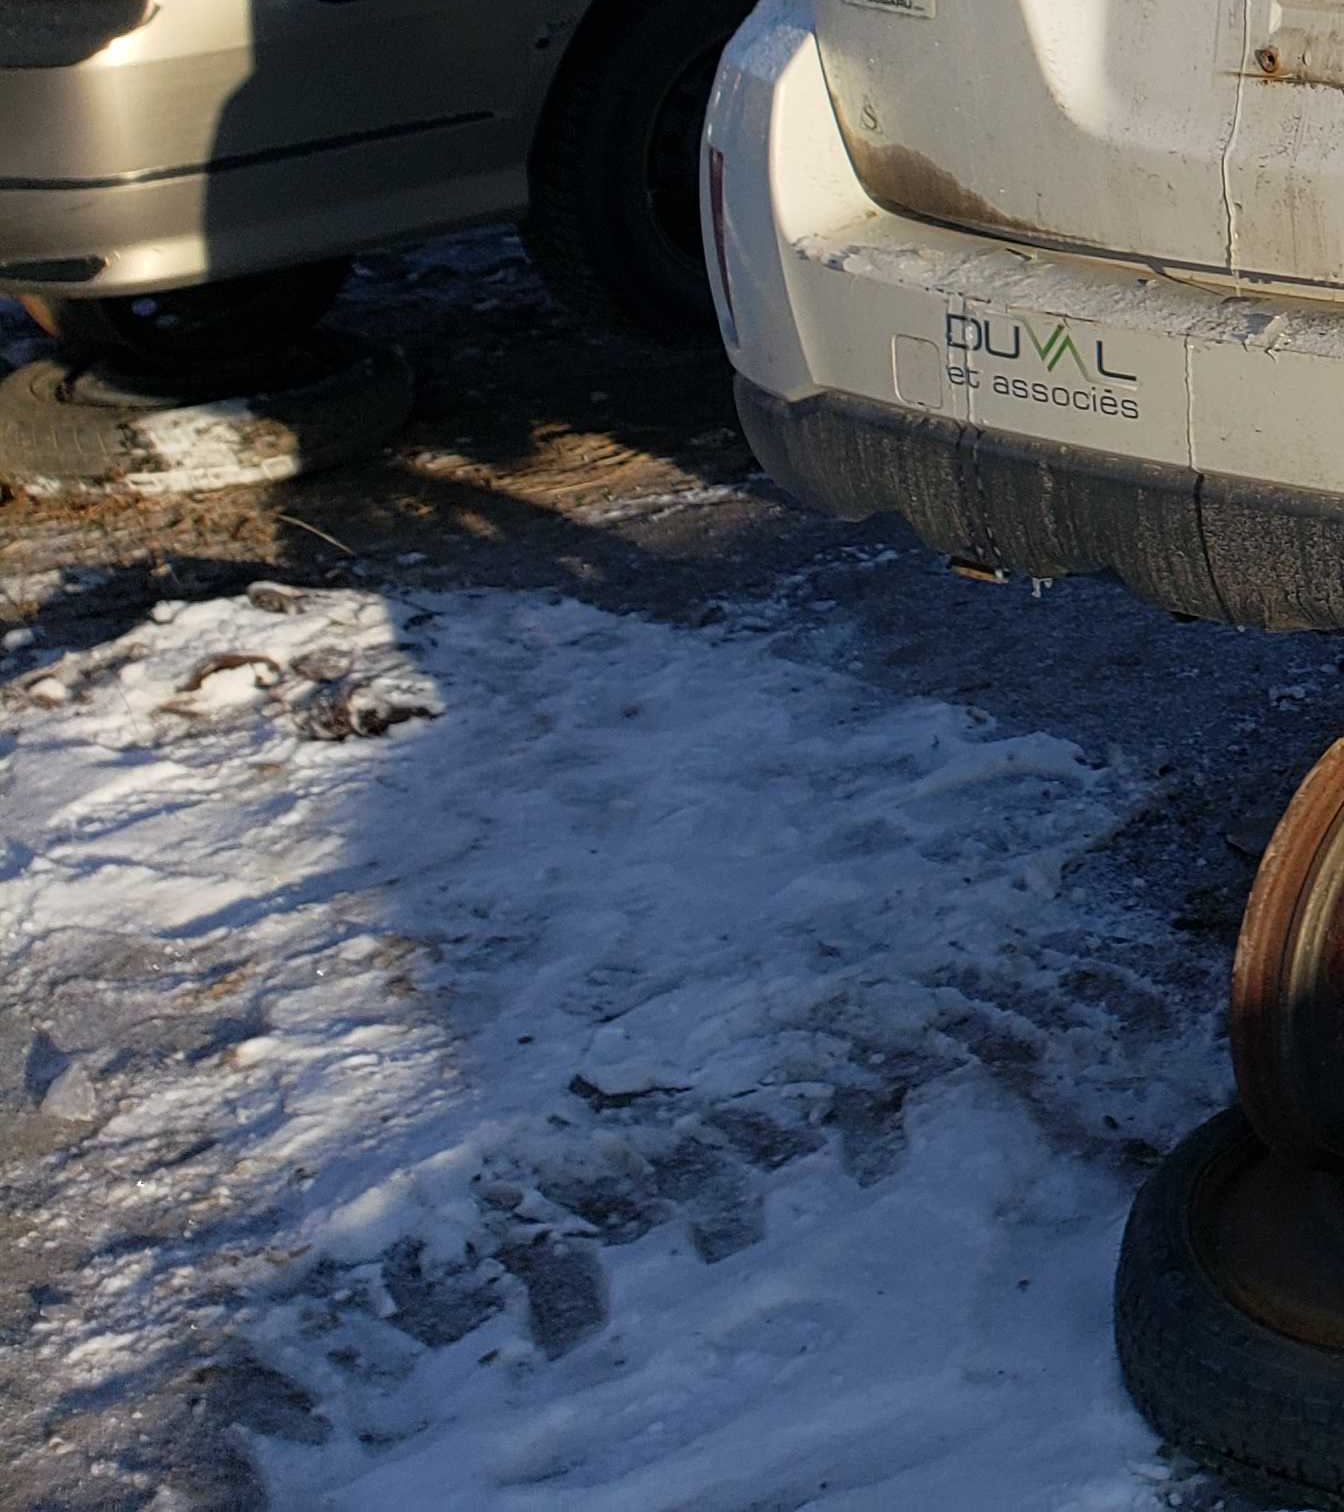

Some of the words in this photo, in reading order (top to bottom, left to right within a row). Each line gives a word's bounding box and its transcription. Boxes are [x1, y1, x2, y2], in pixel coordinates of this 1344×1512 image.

[945, 312, 1138, 383] DUVAL
[947, 364, 982, 389] et
[992, 373, 1140, 420] associés
